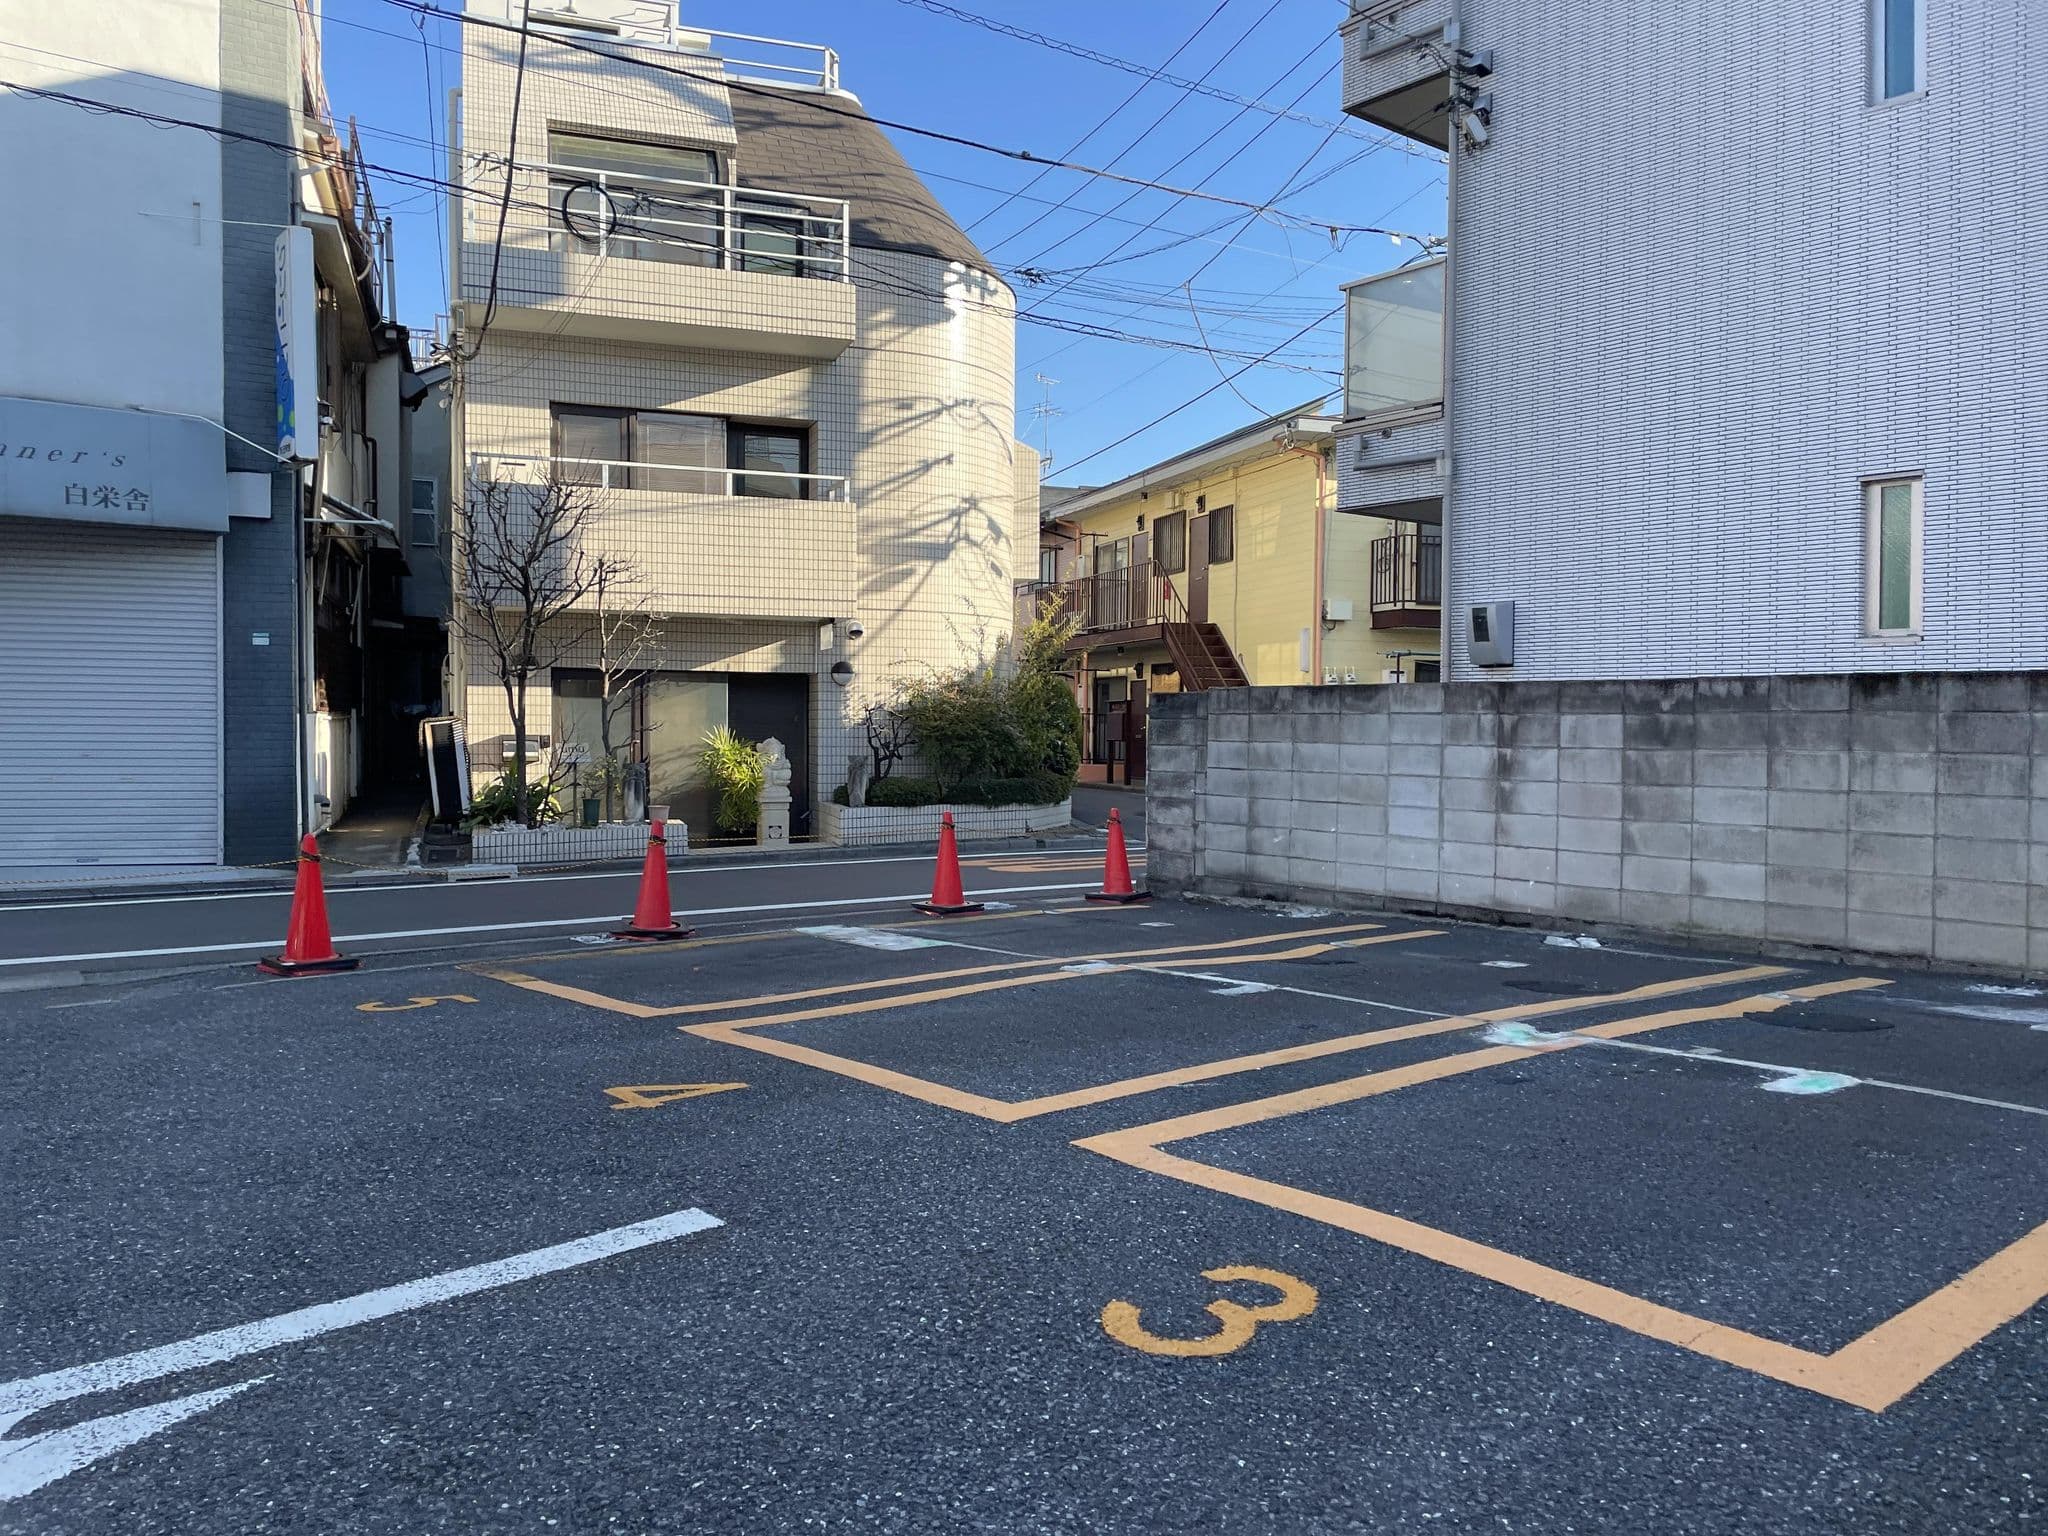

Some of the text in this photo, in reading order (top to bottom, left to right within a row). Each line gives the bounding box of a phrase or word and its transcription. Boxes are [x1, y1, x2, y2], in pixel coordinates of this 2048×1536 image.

[64, 482, 149, 511] 白栄舎
[355, 993, 480, 1013] 5
[603, 1082, 750, 1110] 4
[1100, 1264, 1320, 1357] 3
